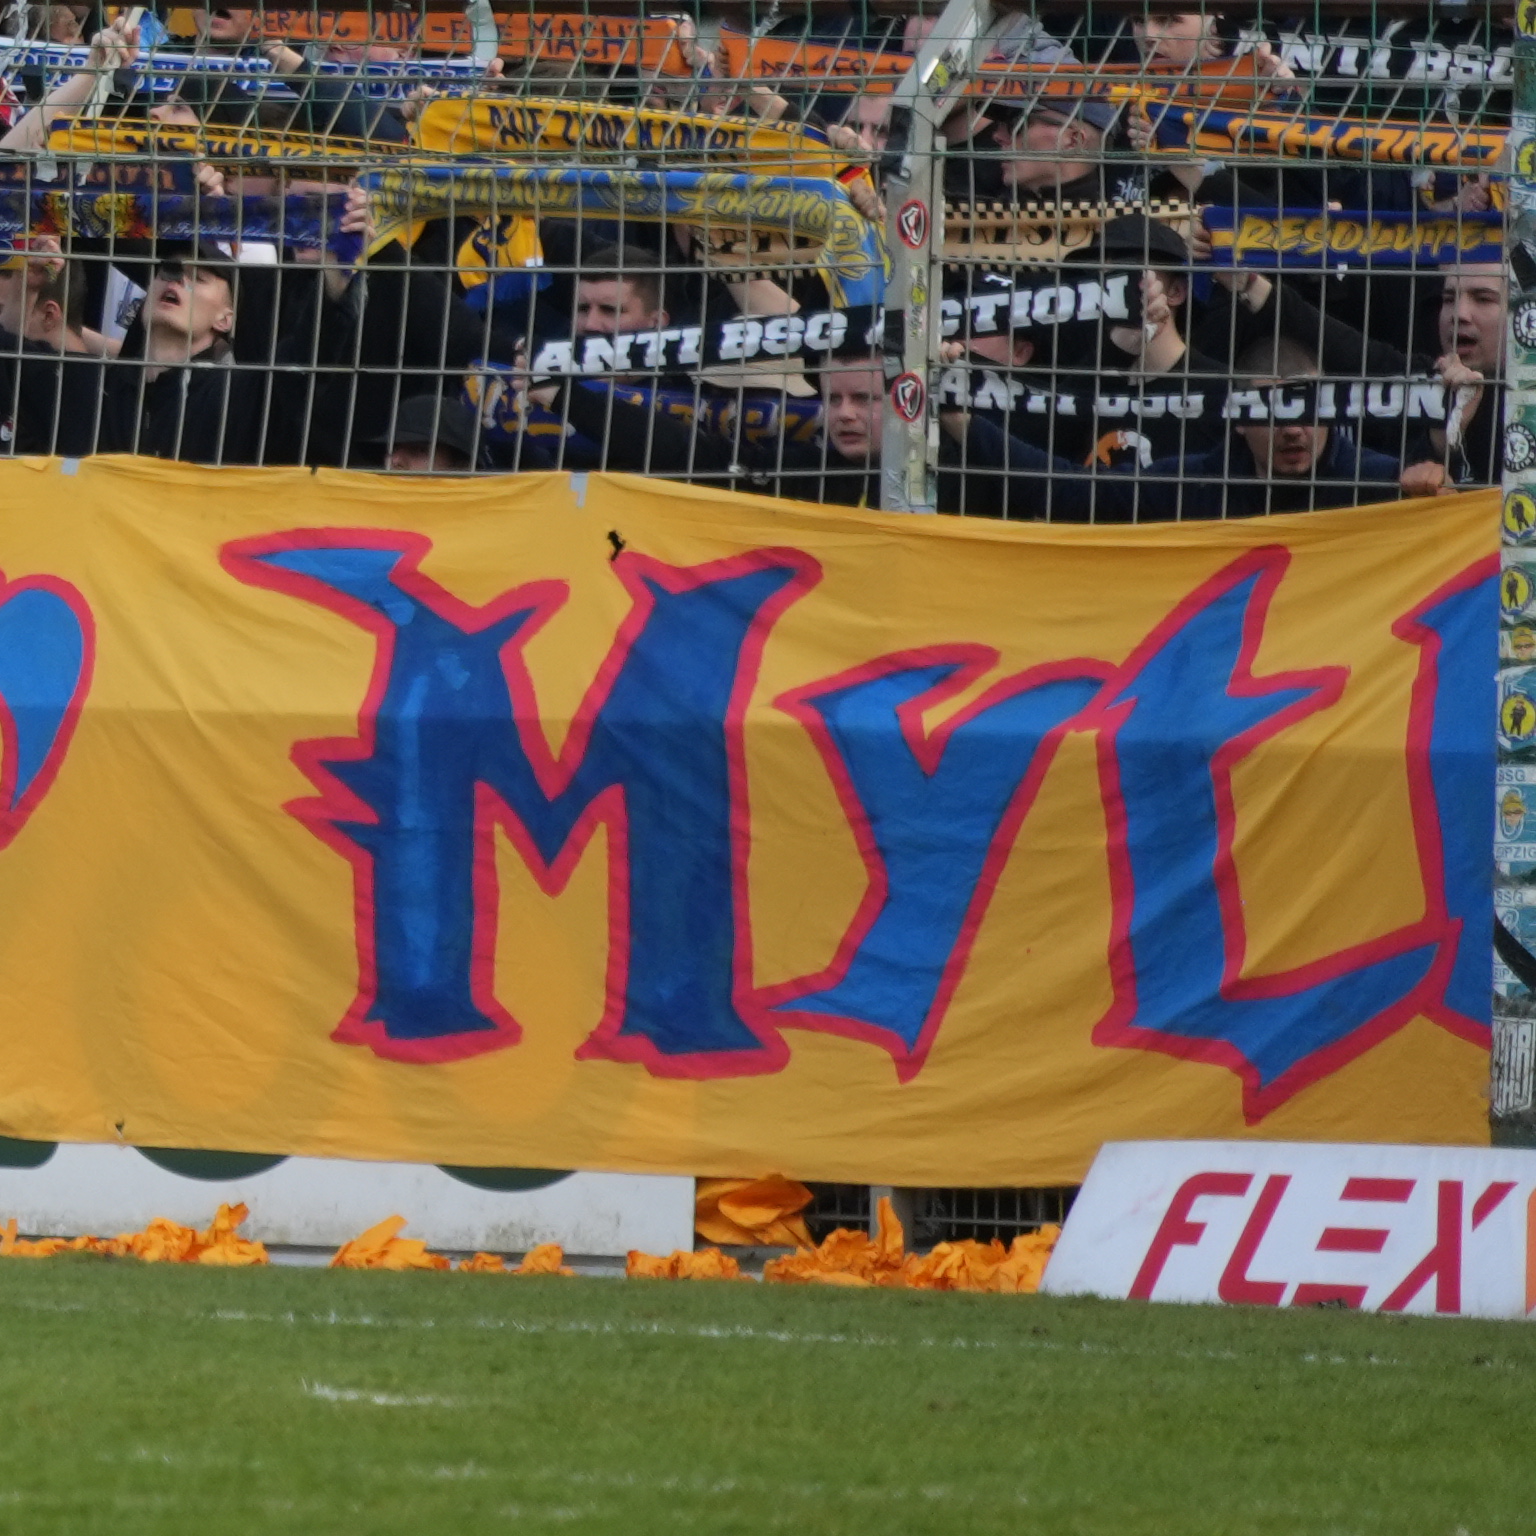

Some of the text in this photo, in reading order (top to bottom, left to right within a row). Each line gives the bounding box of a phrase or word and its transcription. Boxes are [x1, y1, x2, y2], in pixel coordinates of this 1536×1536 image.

[1236, 215, 1488, 264] RESOLUTE
[532, 328, 704, 380] ANTI
[718, 312, 849, 361] BSG
[1126, 1170, 1519, 1316] FLEX
